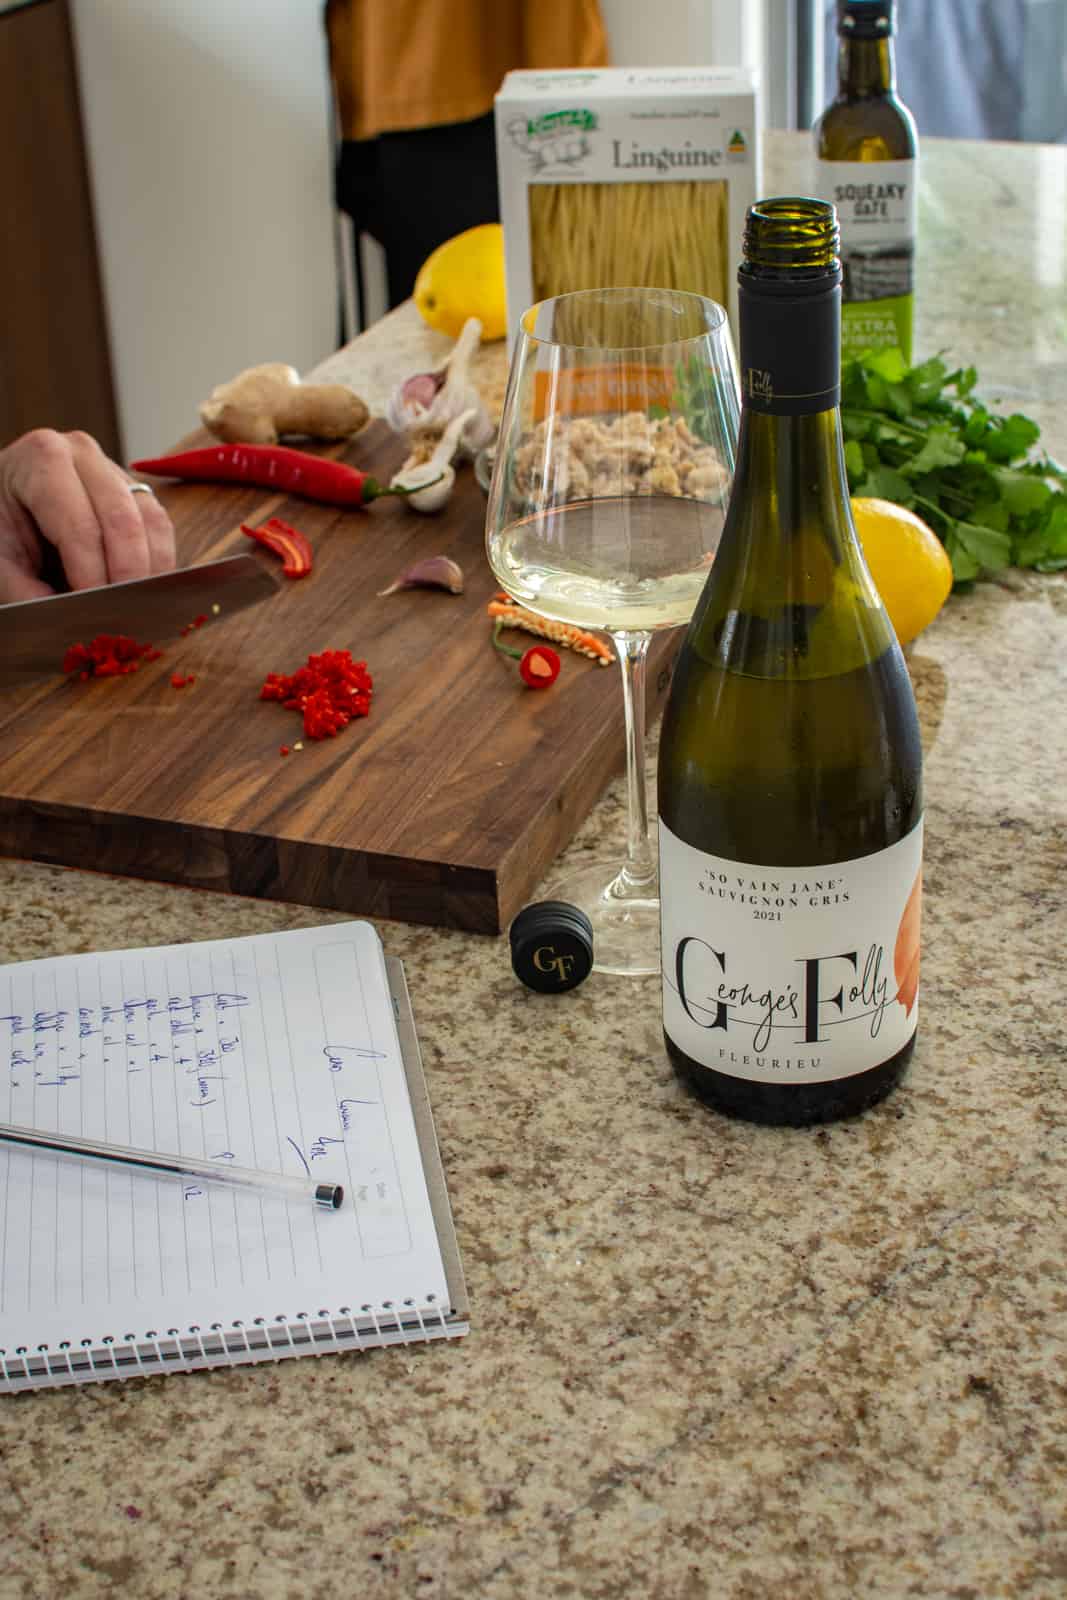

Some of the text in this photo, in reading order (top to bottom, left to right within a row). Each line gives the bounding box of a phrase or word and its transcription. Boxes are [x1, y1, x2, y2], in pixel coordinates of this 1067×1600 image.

[612, 139, 722, 173] Linguine
[835, 184, 907, 201] SQUEAKY
[854, 201, 889, 217] GATE
[697, 881, 850, 907] SAUVIGNON GRIS
[737, 877, 781, 892] VAIN
[752, 910, 783, 921] 2021
[533, 946, 574, 982] GF
[793, 943, 888, 1044] Folly
[718, 1048, 822, 1070] FLEURIEU
